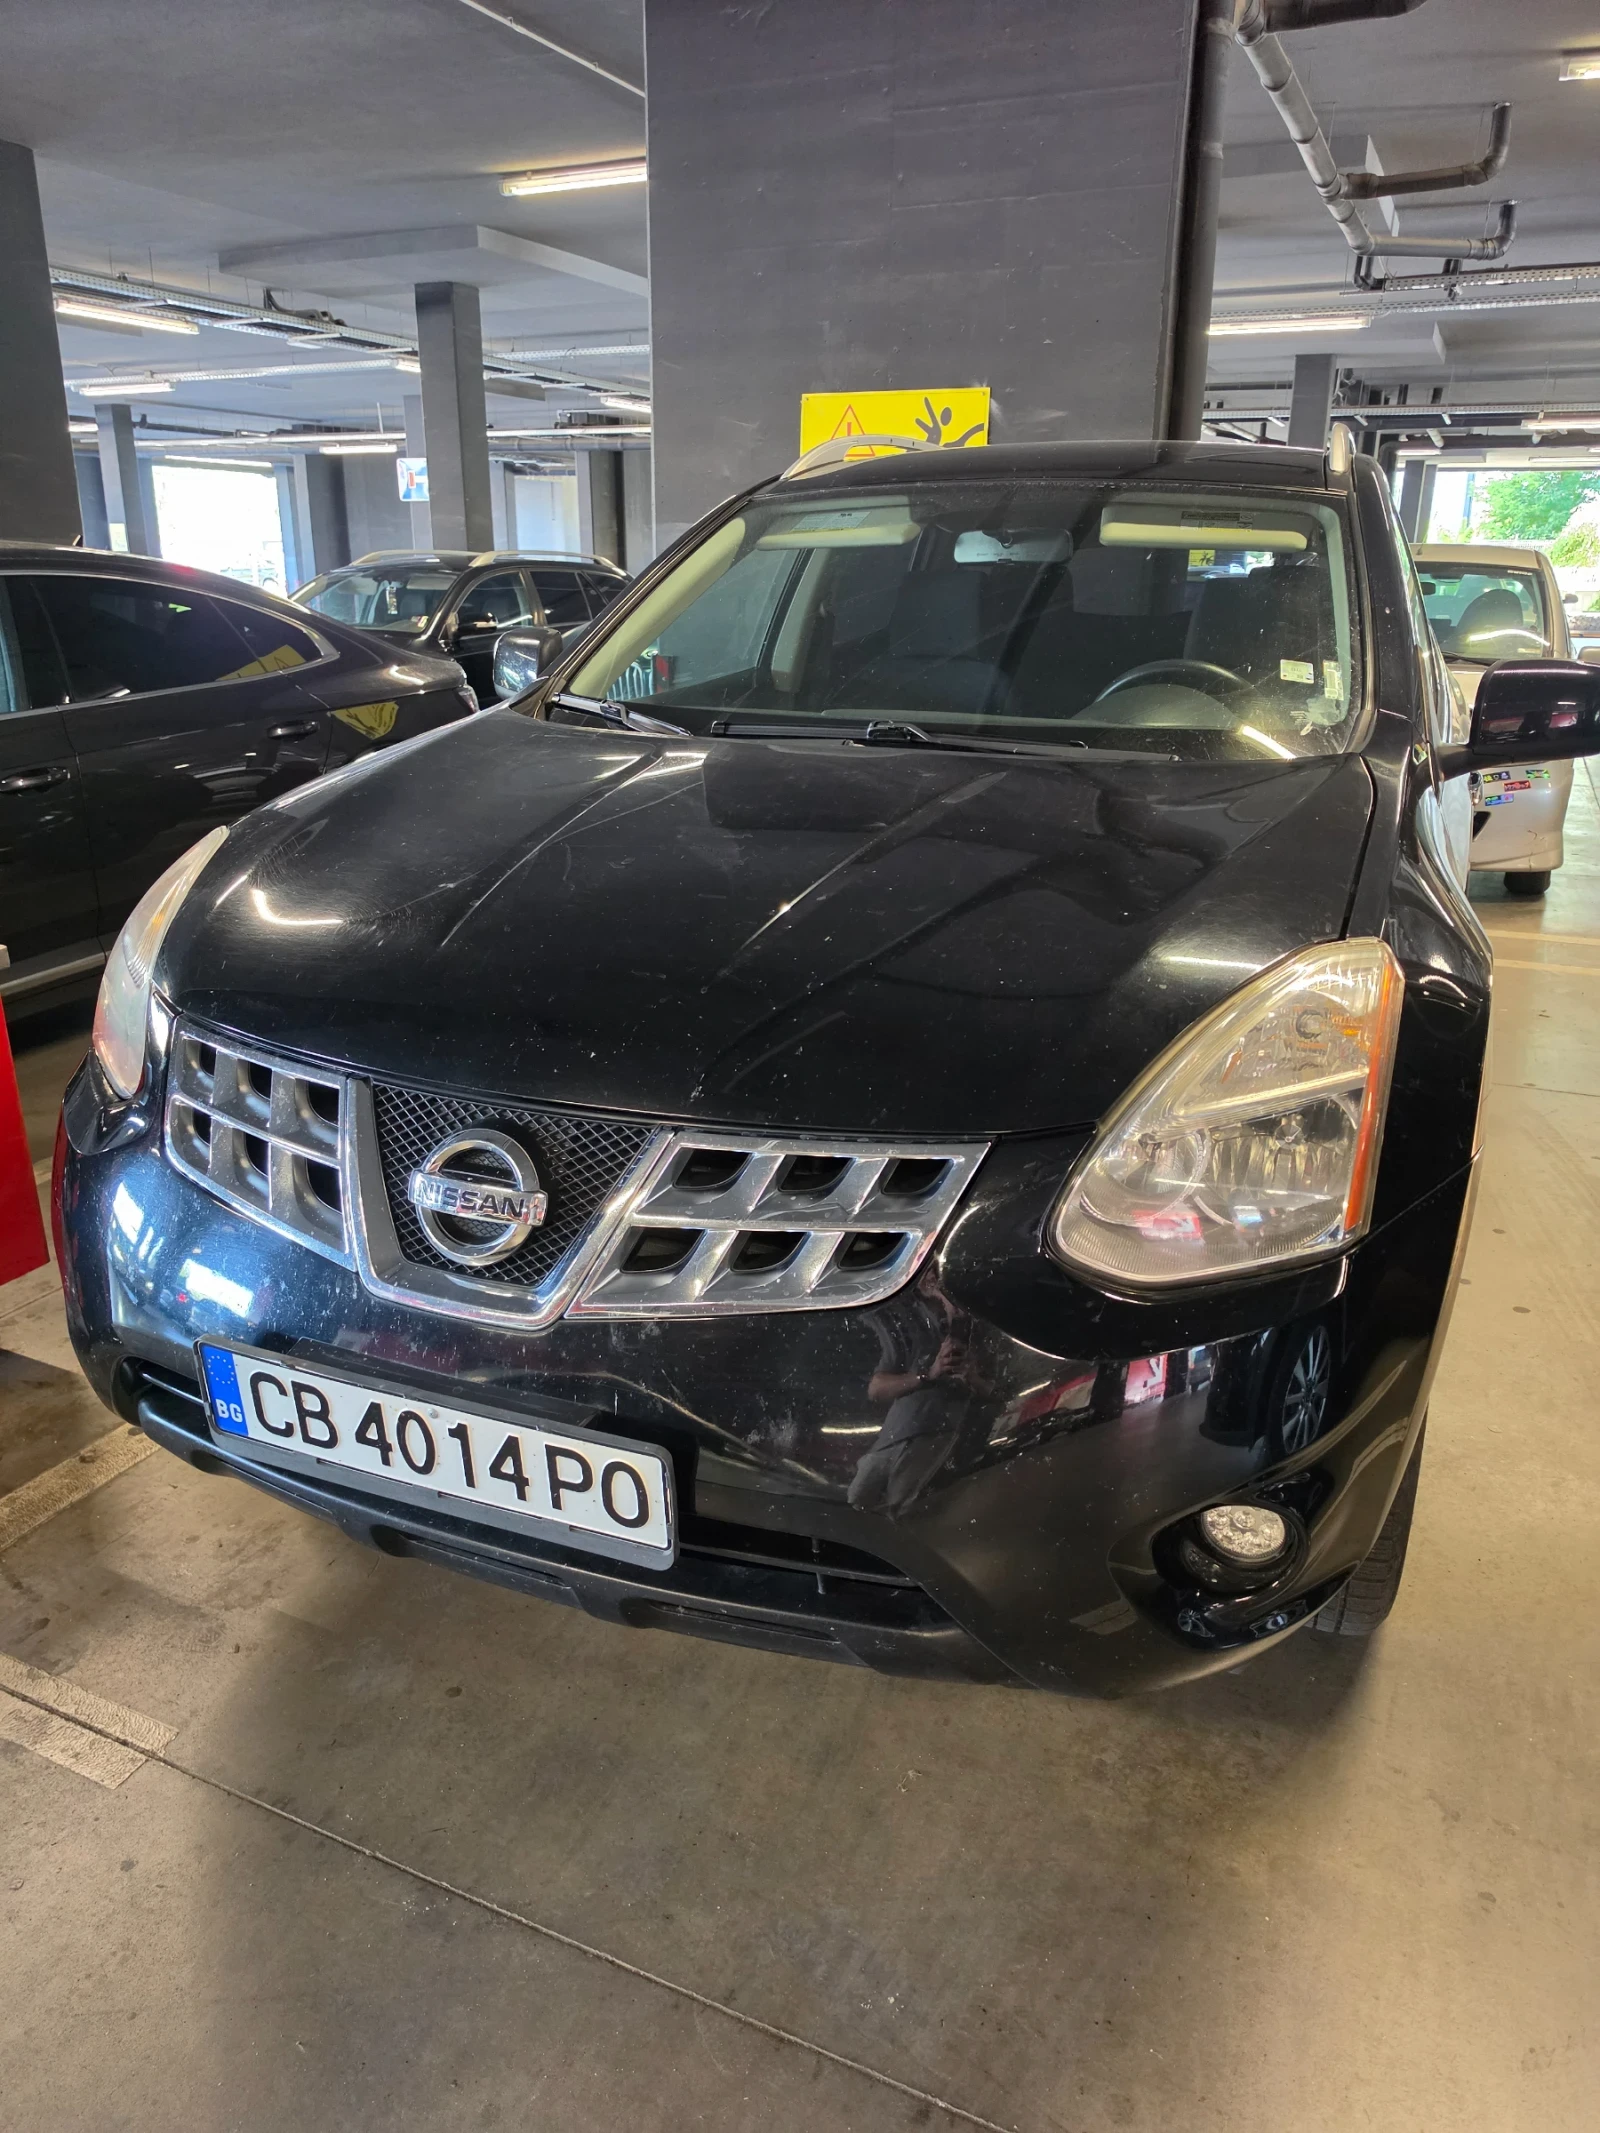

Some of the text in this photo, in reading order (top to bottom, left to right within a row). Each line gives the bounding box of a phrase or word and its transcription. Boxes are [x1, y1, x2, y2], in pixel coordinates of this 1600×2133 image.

[414, 1179, 525, 1218] NISSAN
[216, 1398, 244, 1424] BG
[249, 1371, 339, 1450] CB
[355, 1402, 530, 1502] 4014
